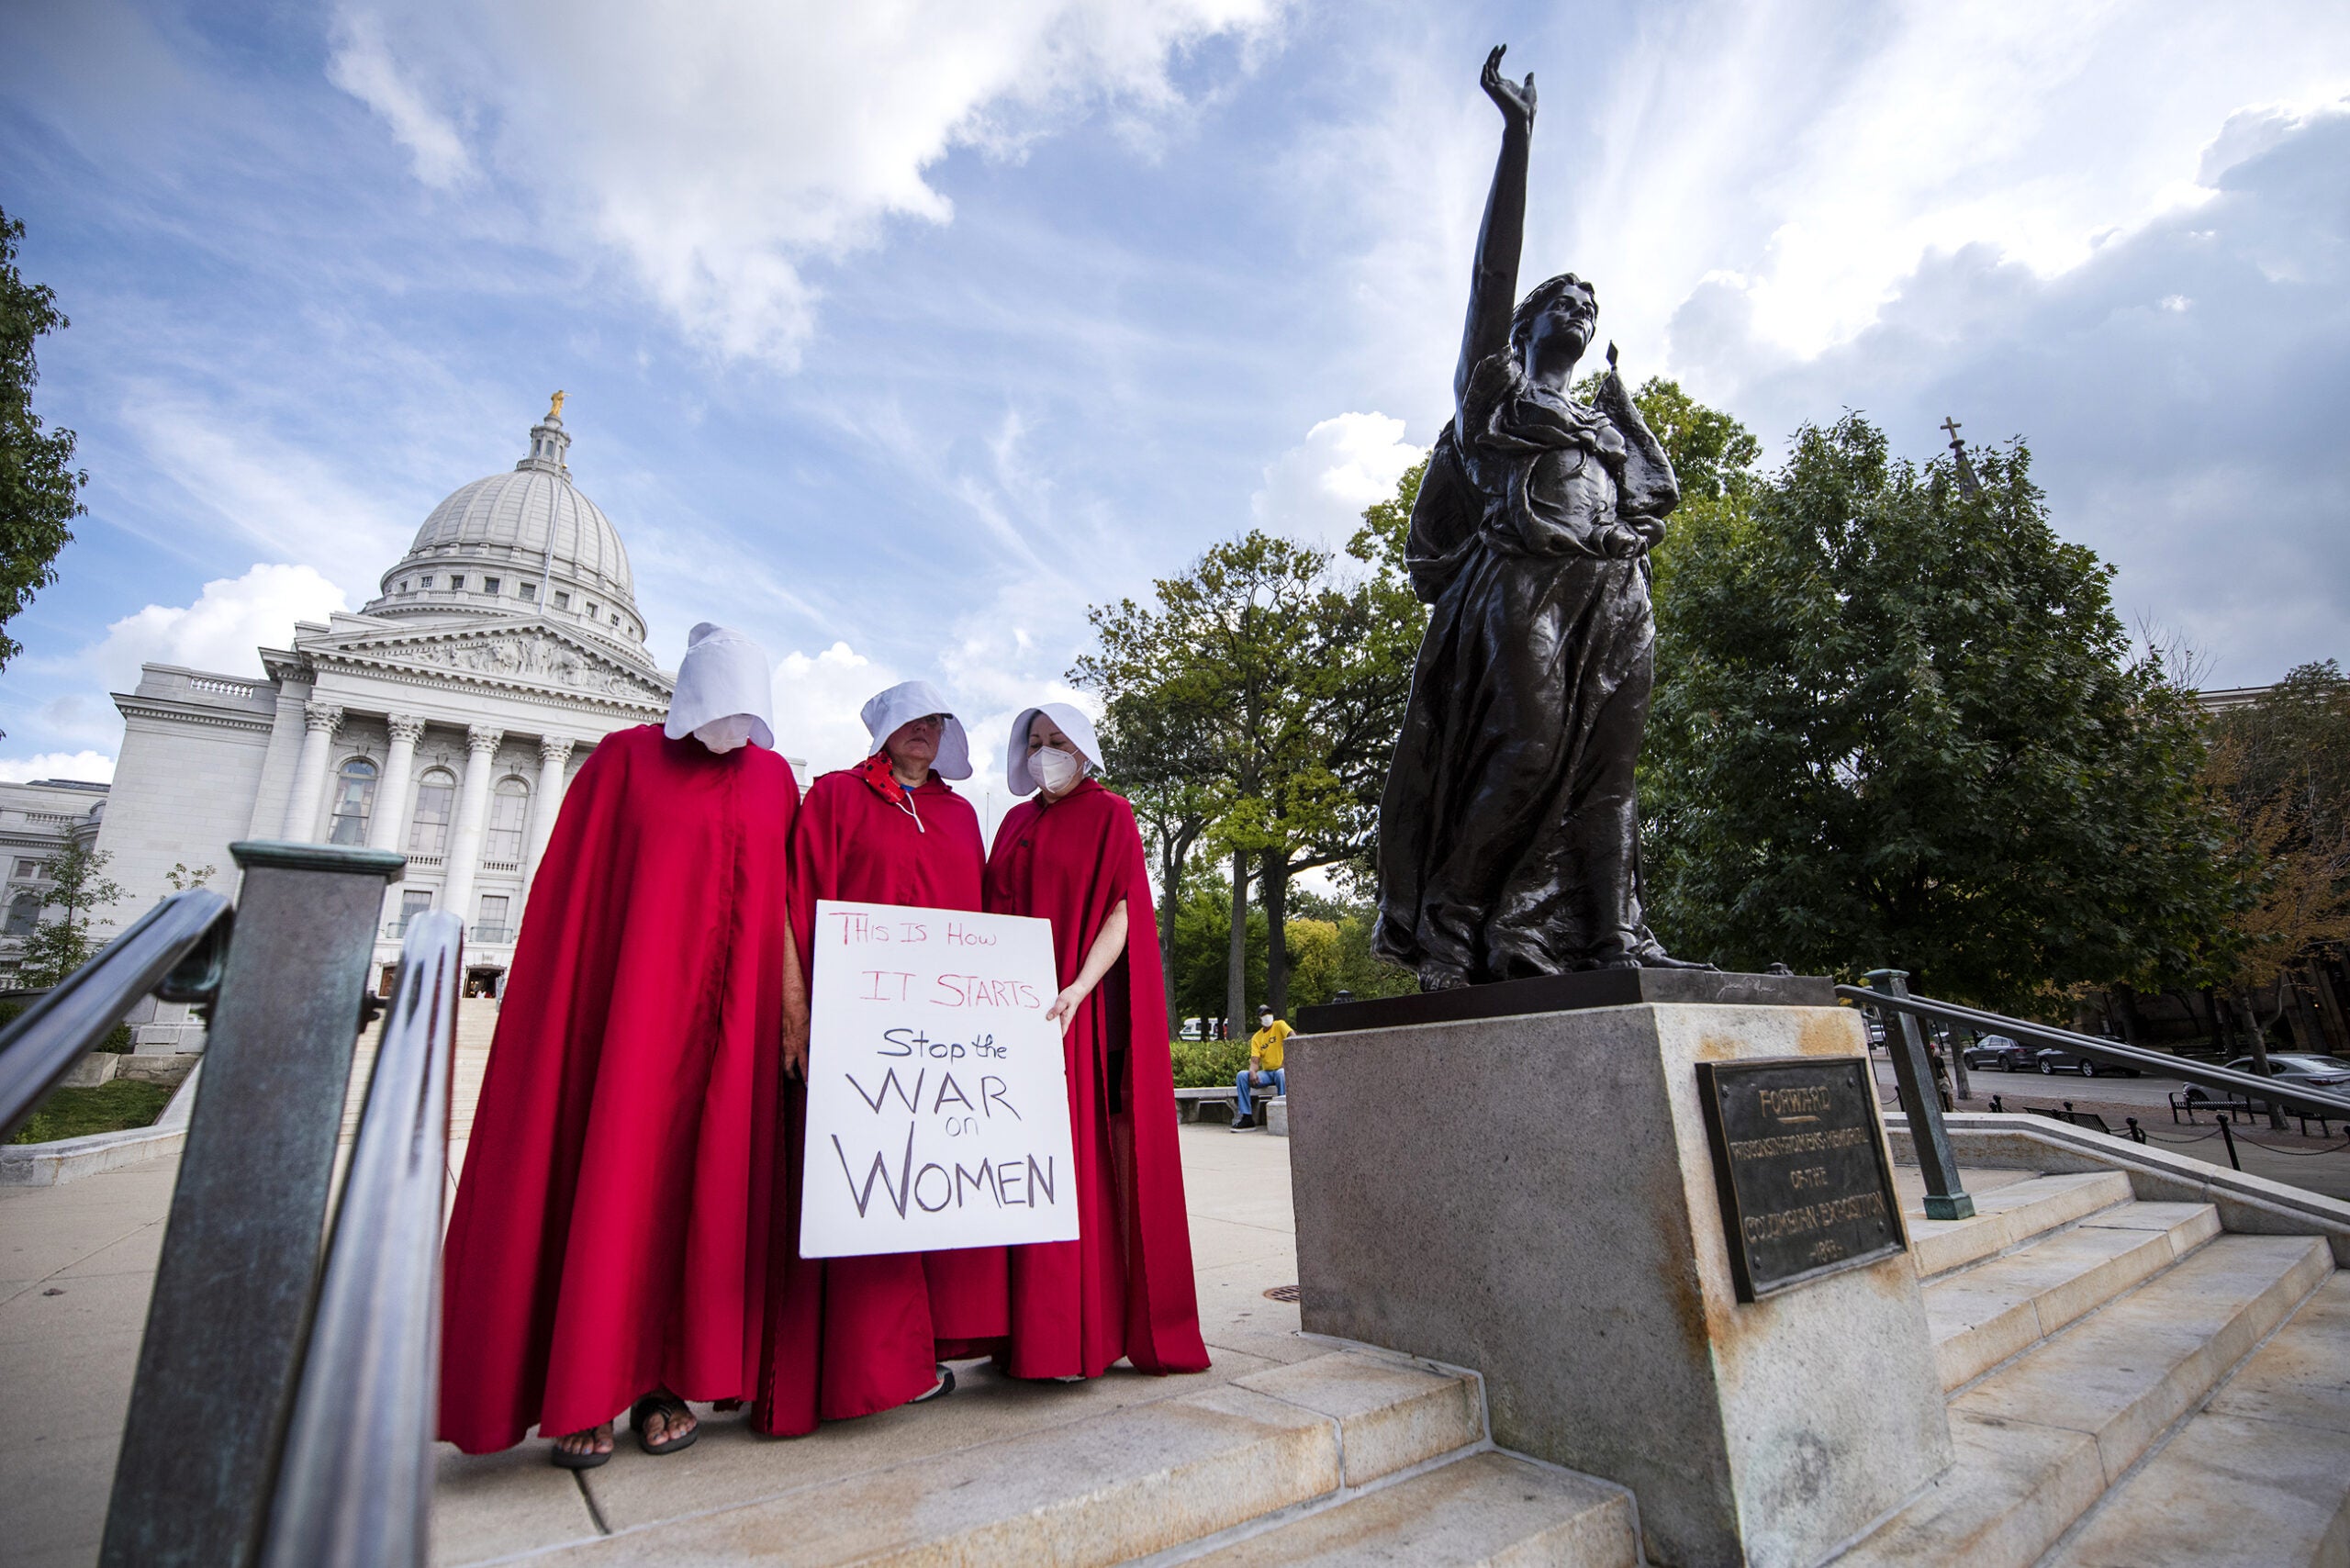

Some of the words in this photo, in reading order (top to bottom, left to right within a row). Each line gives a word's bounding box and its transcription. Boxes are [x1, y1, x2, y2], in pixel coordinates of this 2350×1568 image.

[829, 912, 889, 946] THIS
[900, 922, 927, 944] IS
[859, 970, 916, 1002] IT
[930, 973, 1041, 1009] STARTS
[877, 1028, 966, 1065] Stop
[971, 1034, 1007, 1059] the
[845, 1067, 1022, 1122] WAR
[1759, 1086, 1830, 1117] FORWARD
[946, 1116, 979, 1137] on
[831, 1120, 1055, 1220] WOMEN
